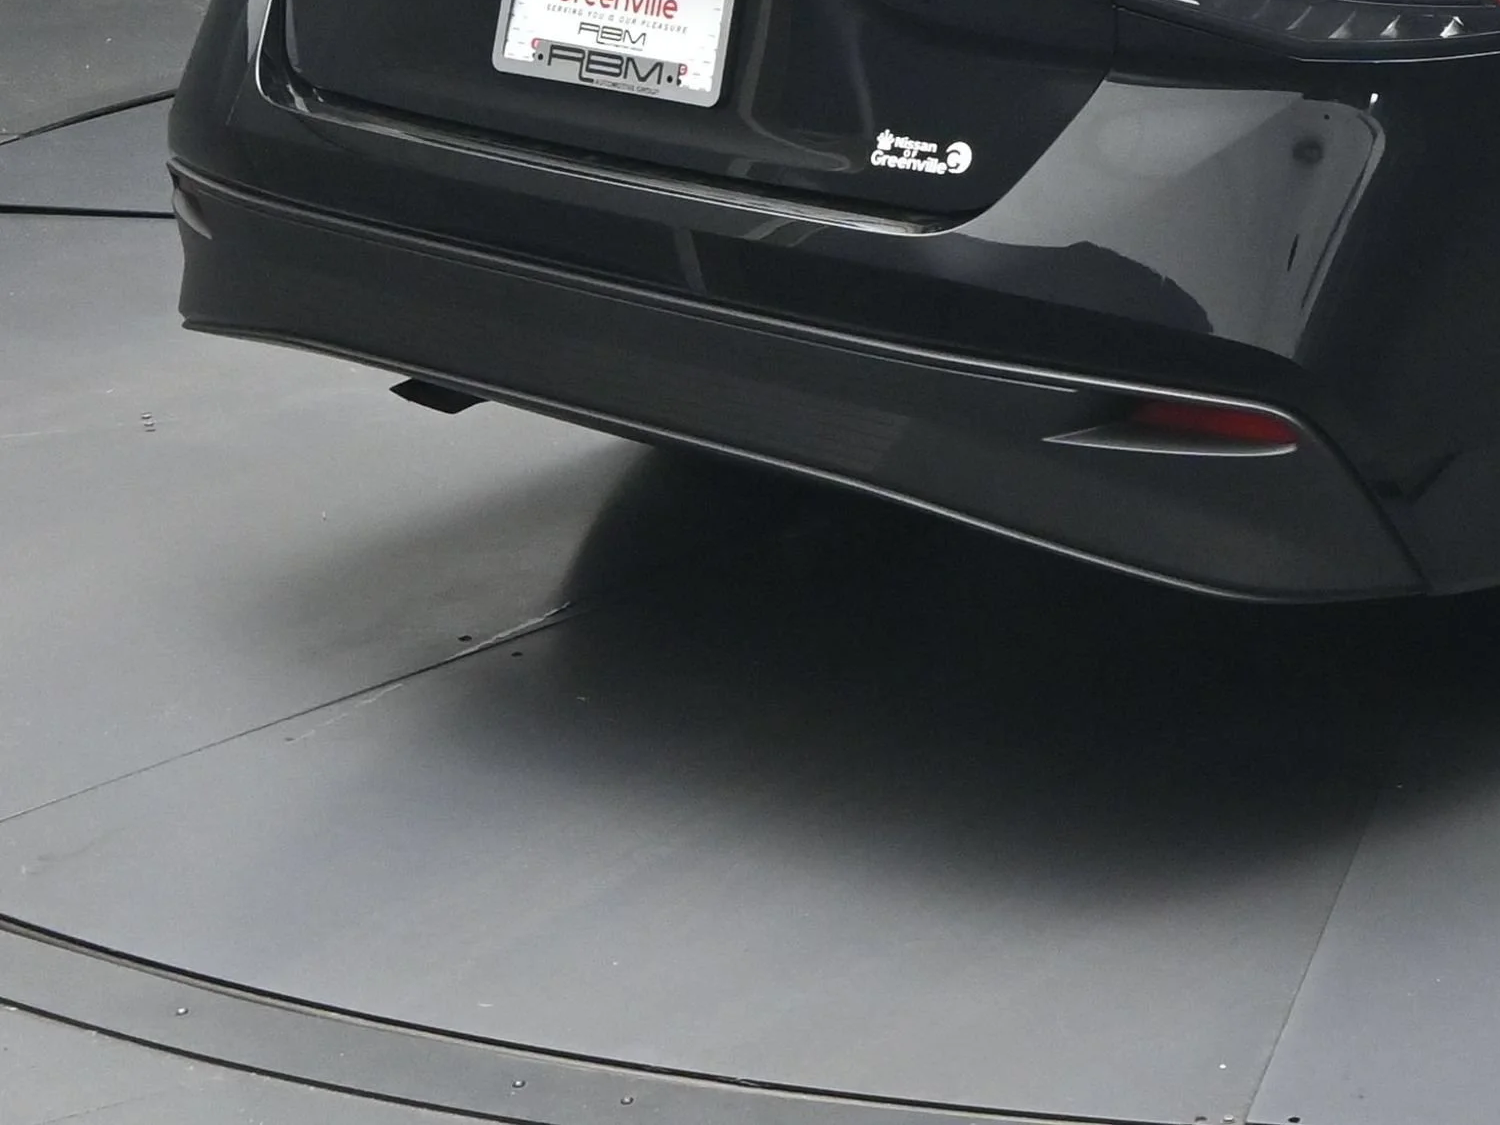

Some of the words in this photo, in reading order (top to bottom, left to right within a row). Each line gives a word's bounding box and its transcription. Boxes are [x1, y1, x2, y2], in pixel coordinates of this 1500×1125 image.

[546, 3, 583, 17] SERVING
[587, 11, 604, 20] YOU
[619, 15, 637, 25] OUR
[641, 19, 689, 35] PLEASURE
[894, 135, 938, 154] Nissan
[870, 148, 948, 175] Greenville
